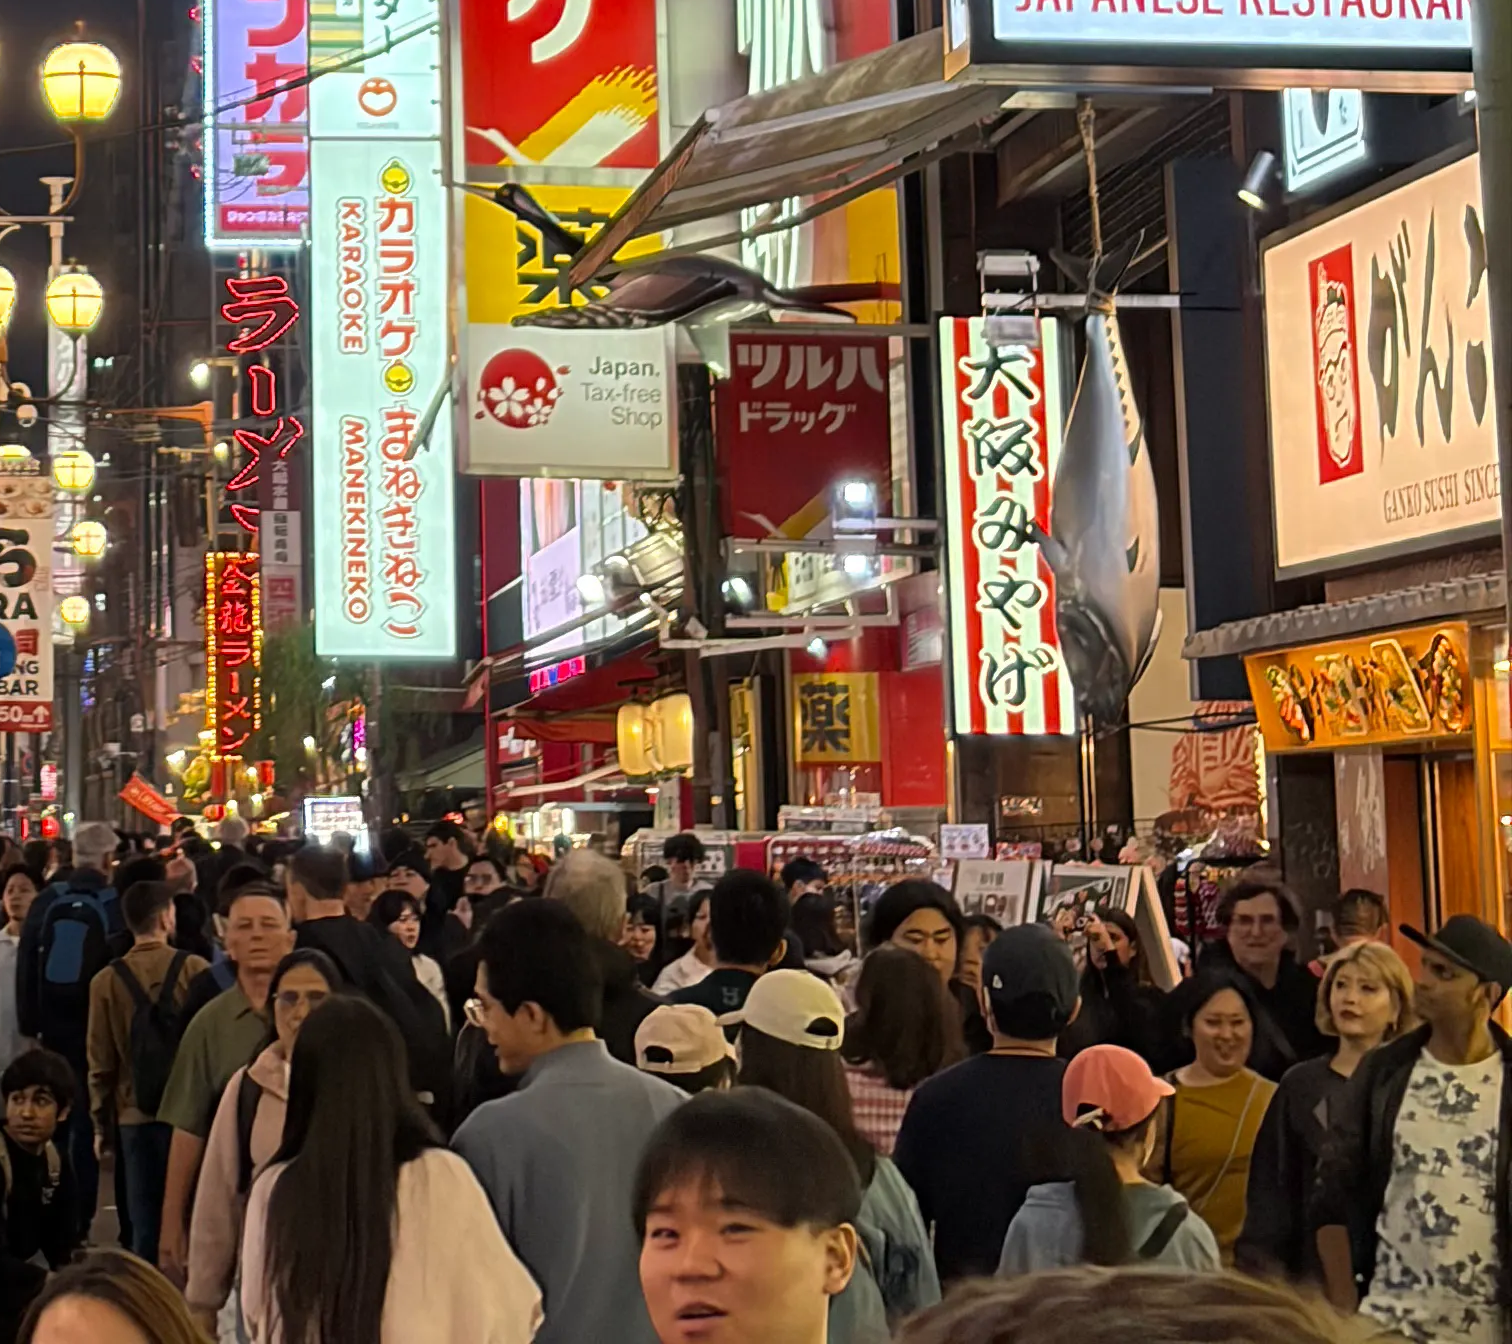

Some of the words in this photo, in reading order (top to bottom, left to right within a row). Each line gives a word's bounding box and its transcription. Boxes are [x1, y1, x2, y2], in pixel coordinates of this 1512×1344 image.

[341, 201, 365, 350] KARAOKE
[379, 199, 416, 358] カラオケ
[579, 382, 662, 405] Tax-free
[588, 355, 662, 381] Japan.
[736, 345, 884, 392] ツルハ
[610, 406, 663, 430] Shop
[739, 400, 856, 435] ドラッグ
[344, 419, 370, 621] MANEKINEKO
[381, 405, 424, 639] まねきねこ
[962, 343, 1056, 709] 大阪みやげ
[1382, 482, 1422, 525] GANKO
[1423, 473, 1460, 516] SUSHI
[218, 559, 254, 750] 金龍ラーメン
[799, 683, 850, 752] 薬
